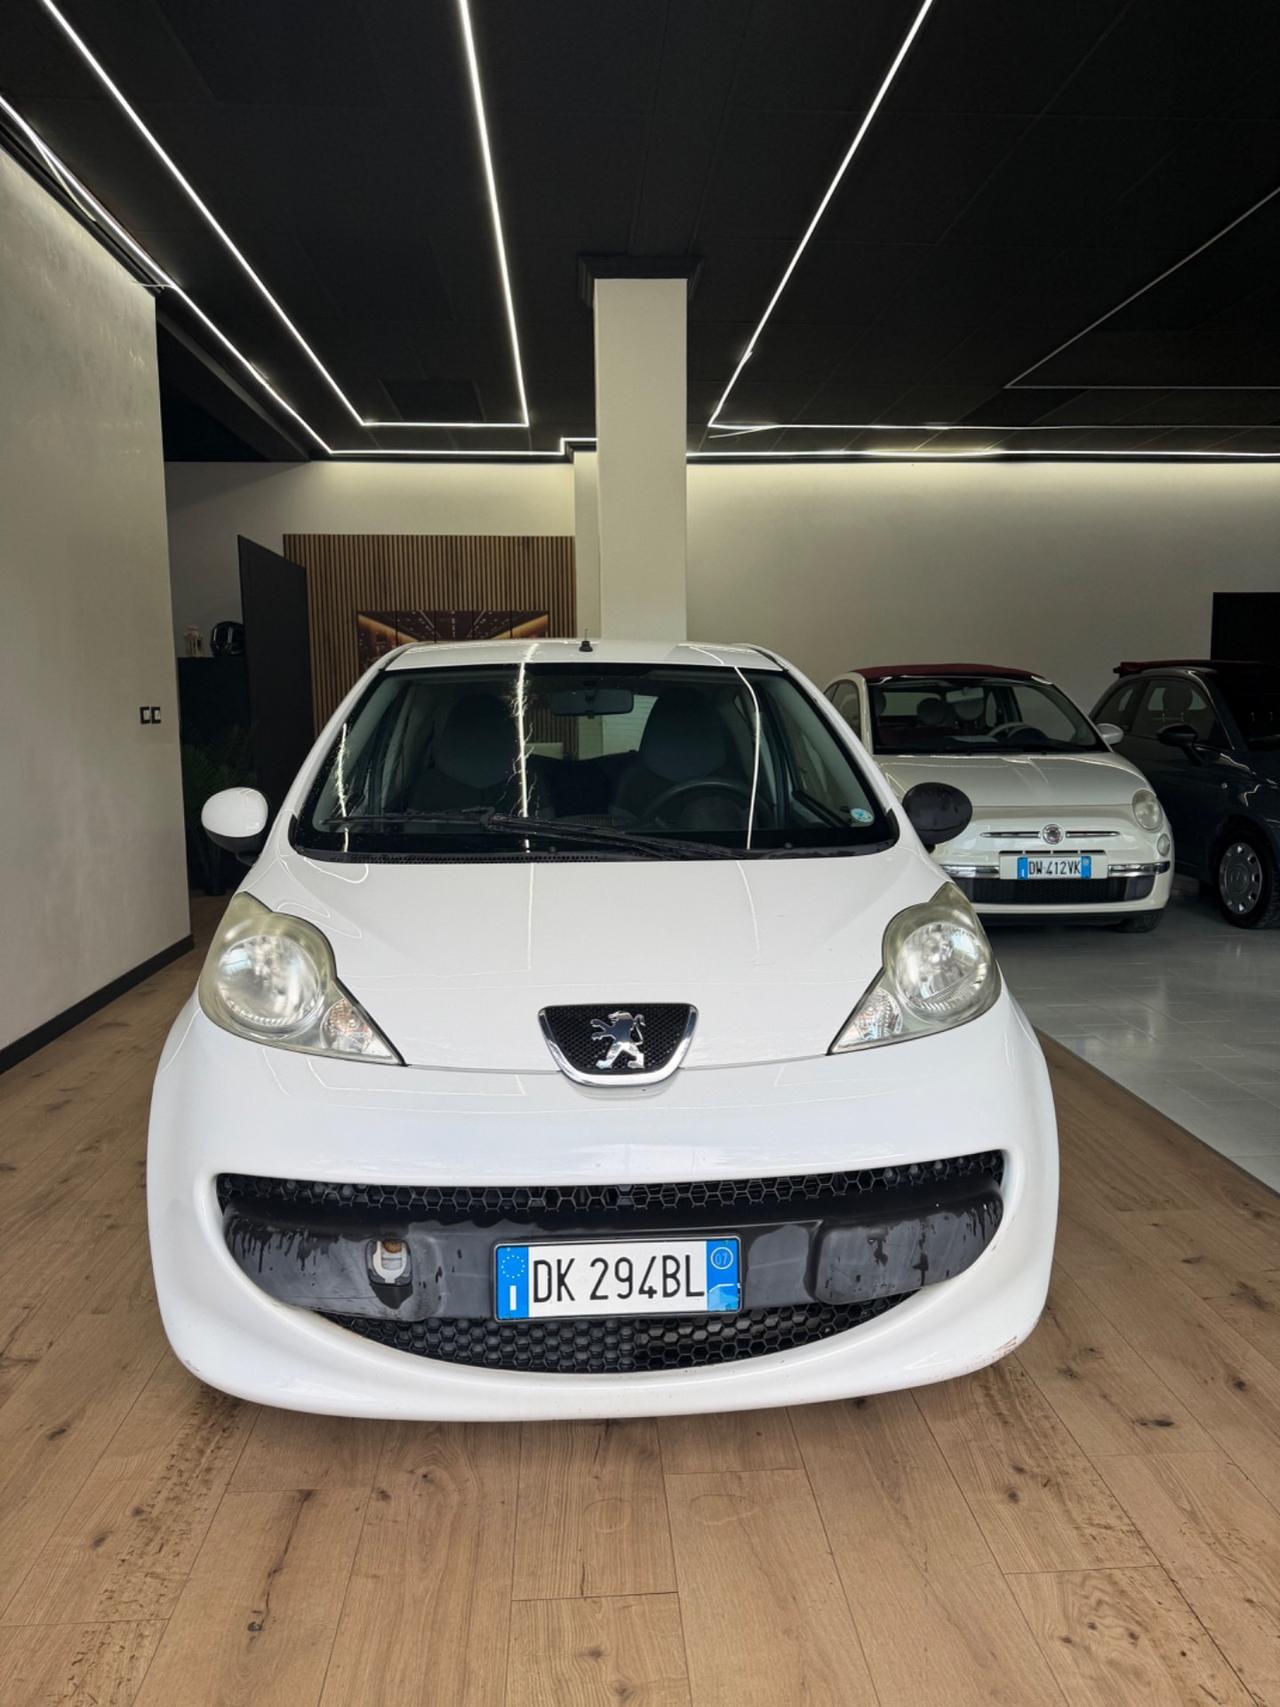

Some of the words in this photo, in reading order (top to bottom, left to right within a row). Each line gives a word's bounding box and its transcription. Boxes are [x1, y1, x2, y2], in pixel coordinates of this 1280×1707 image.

[1028, 861, 1043, 875] DW
[1046, 860, 1081, 874] 412VK
[715, 1252, 728, 1265] 07
[533, 1258, 575, 1303] DK
[590, 1255, 705, 1300] 294BL
[509, 1285, 517, 1311] I
